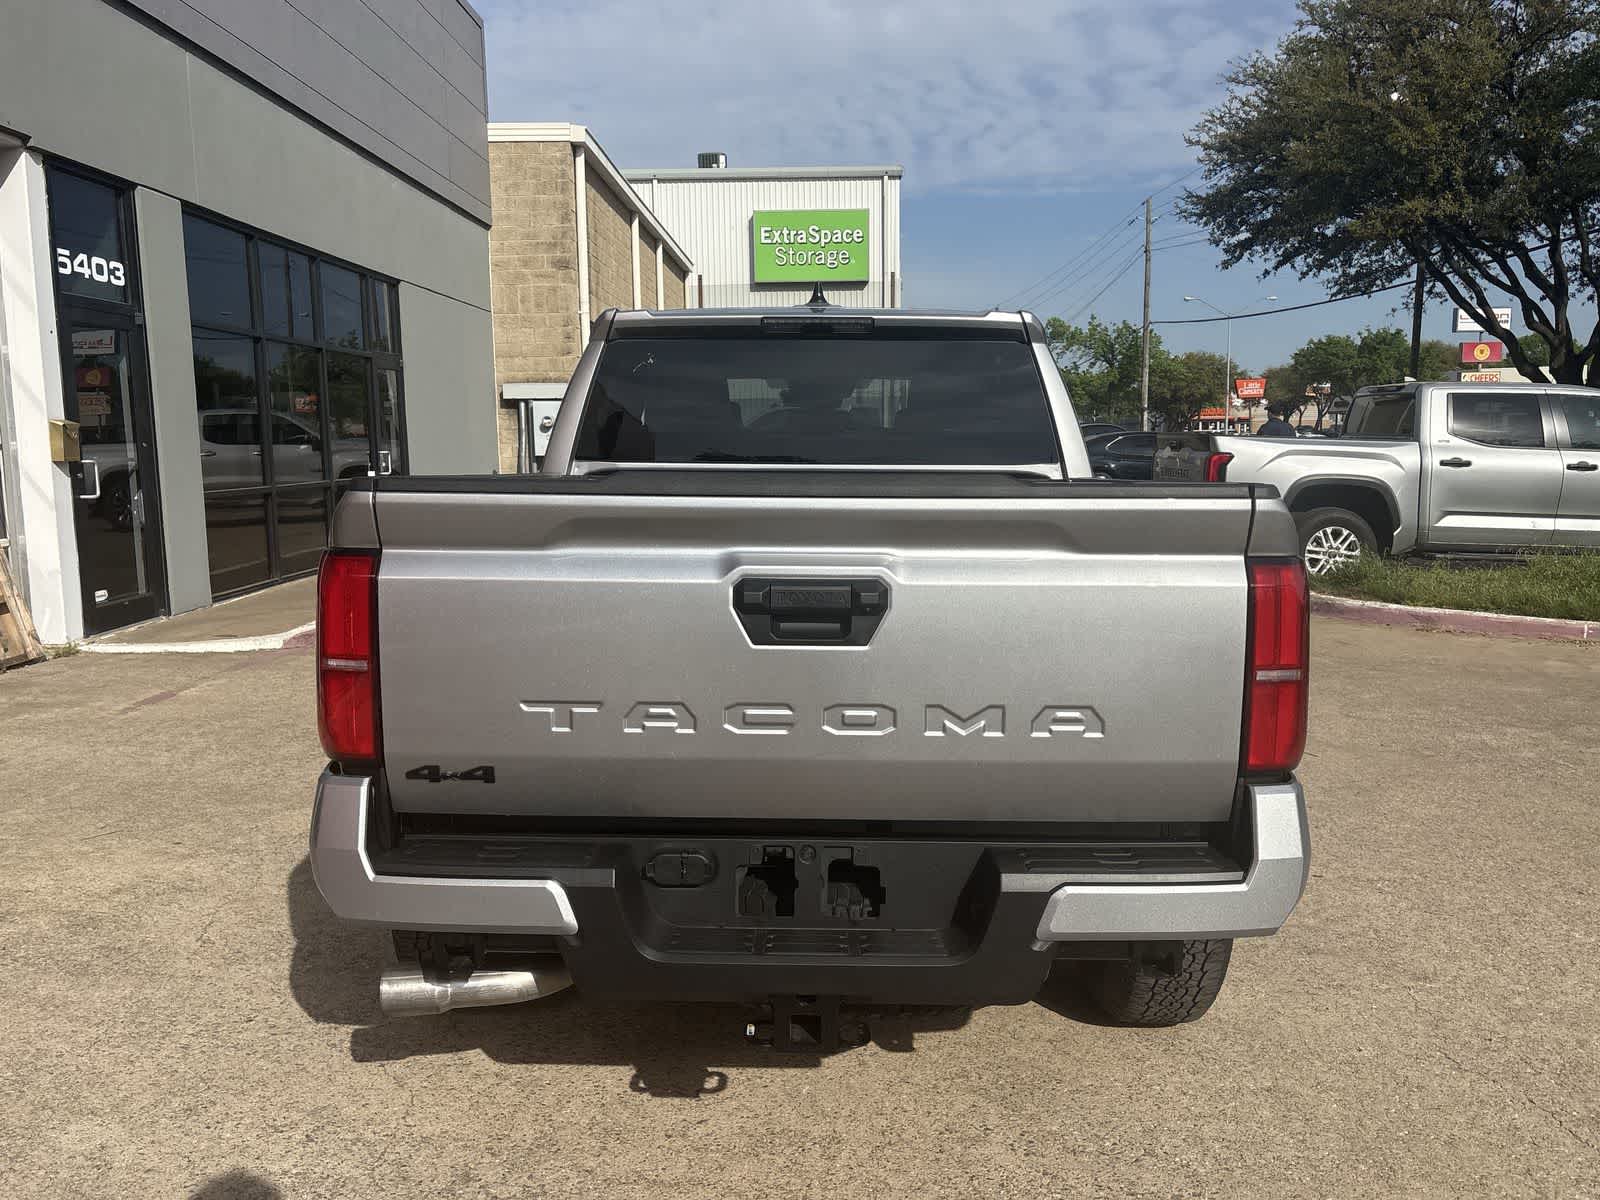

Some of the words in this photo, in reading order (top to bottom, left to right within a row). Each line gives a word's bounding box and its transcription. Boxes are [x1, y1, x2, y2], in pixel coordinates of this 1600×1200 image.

[56, 248, 126, 287] 5403
[775, 247, 850, 268] Storage
[1470, 373, 1499, 383] CHEERS
[519, 700, 1105, 738] TACOMA
